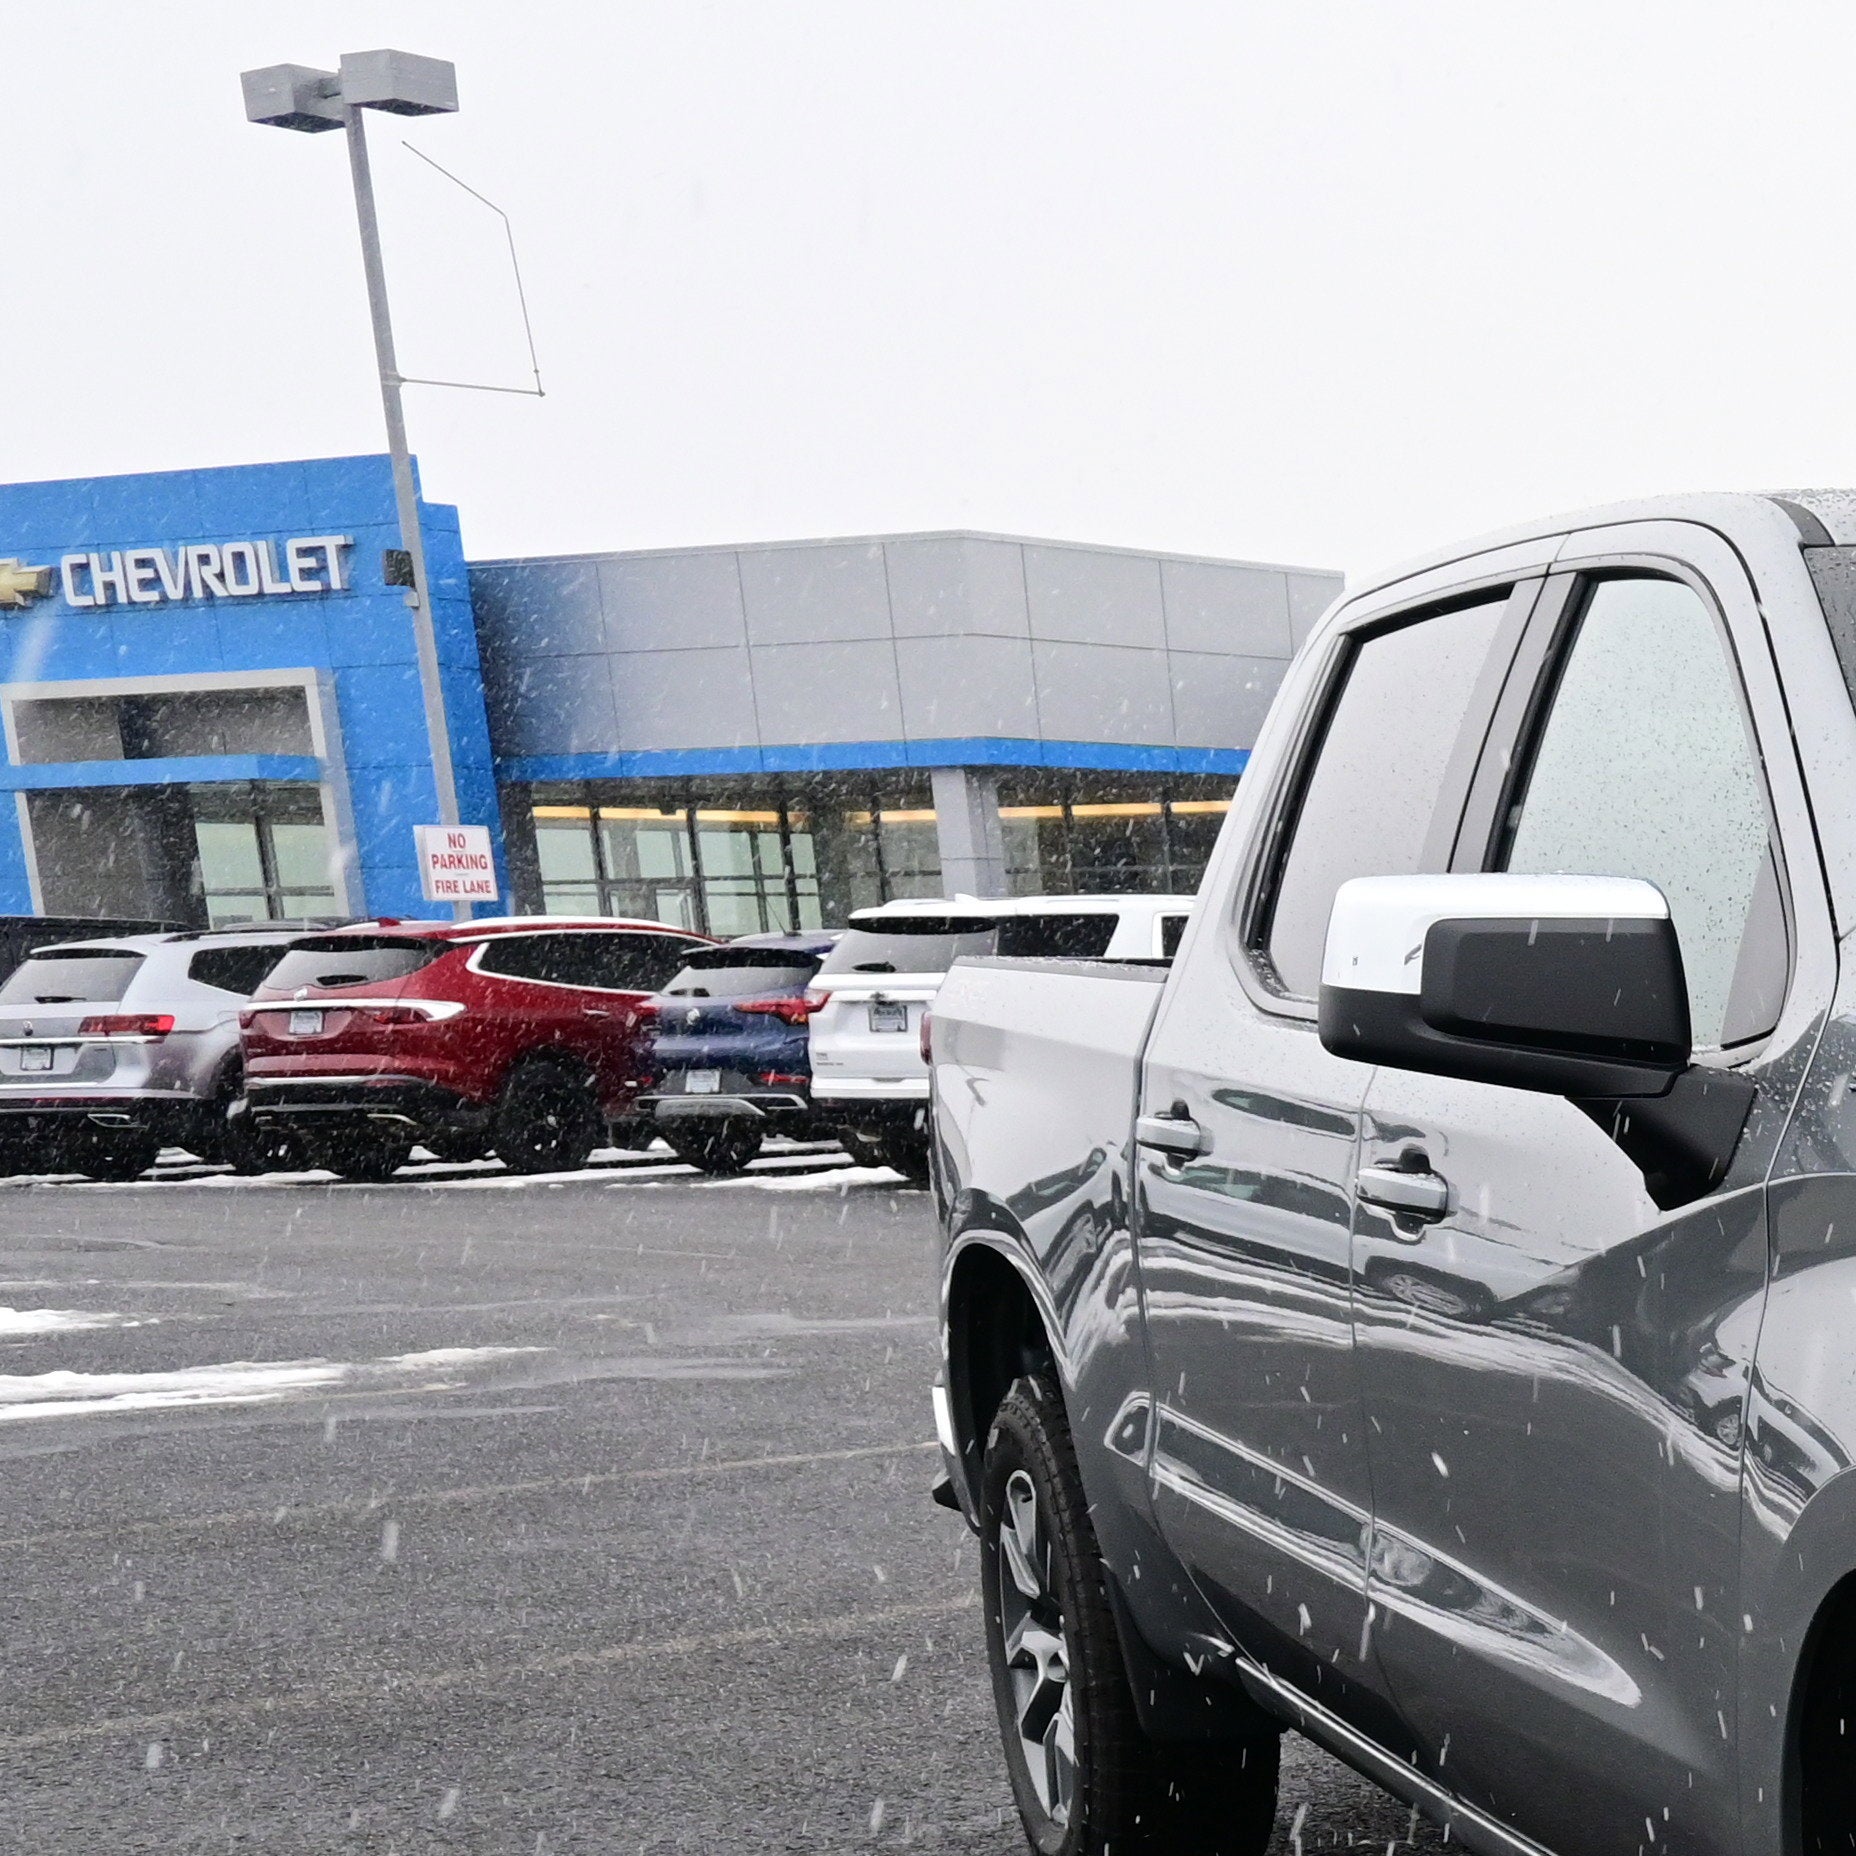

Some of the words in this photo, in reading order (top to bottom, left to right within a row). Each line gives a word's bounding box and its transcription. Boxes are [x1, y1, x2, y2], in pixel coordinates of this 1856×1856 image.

[61, 535, 351, 607] CHEVROLET
[447, 832, 467, 849] NO
[431, 853, 488, 870] PARKING
[435, 879, 460, 894] FIRE
[463, 879, 492, 894] LANE
